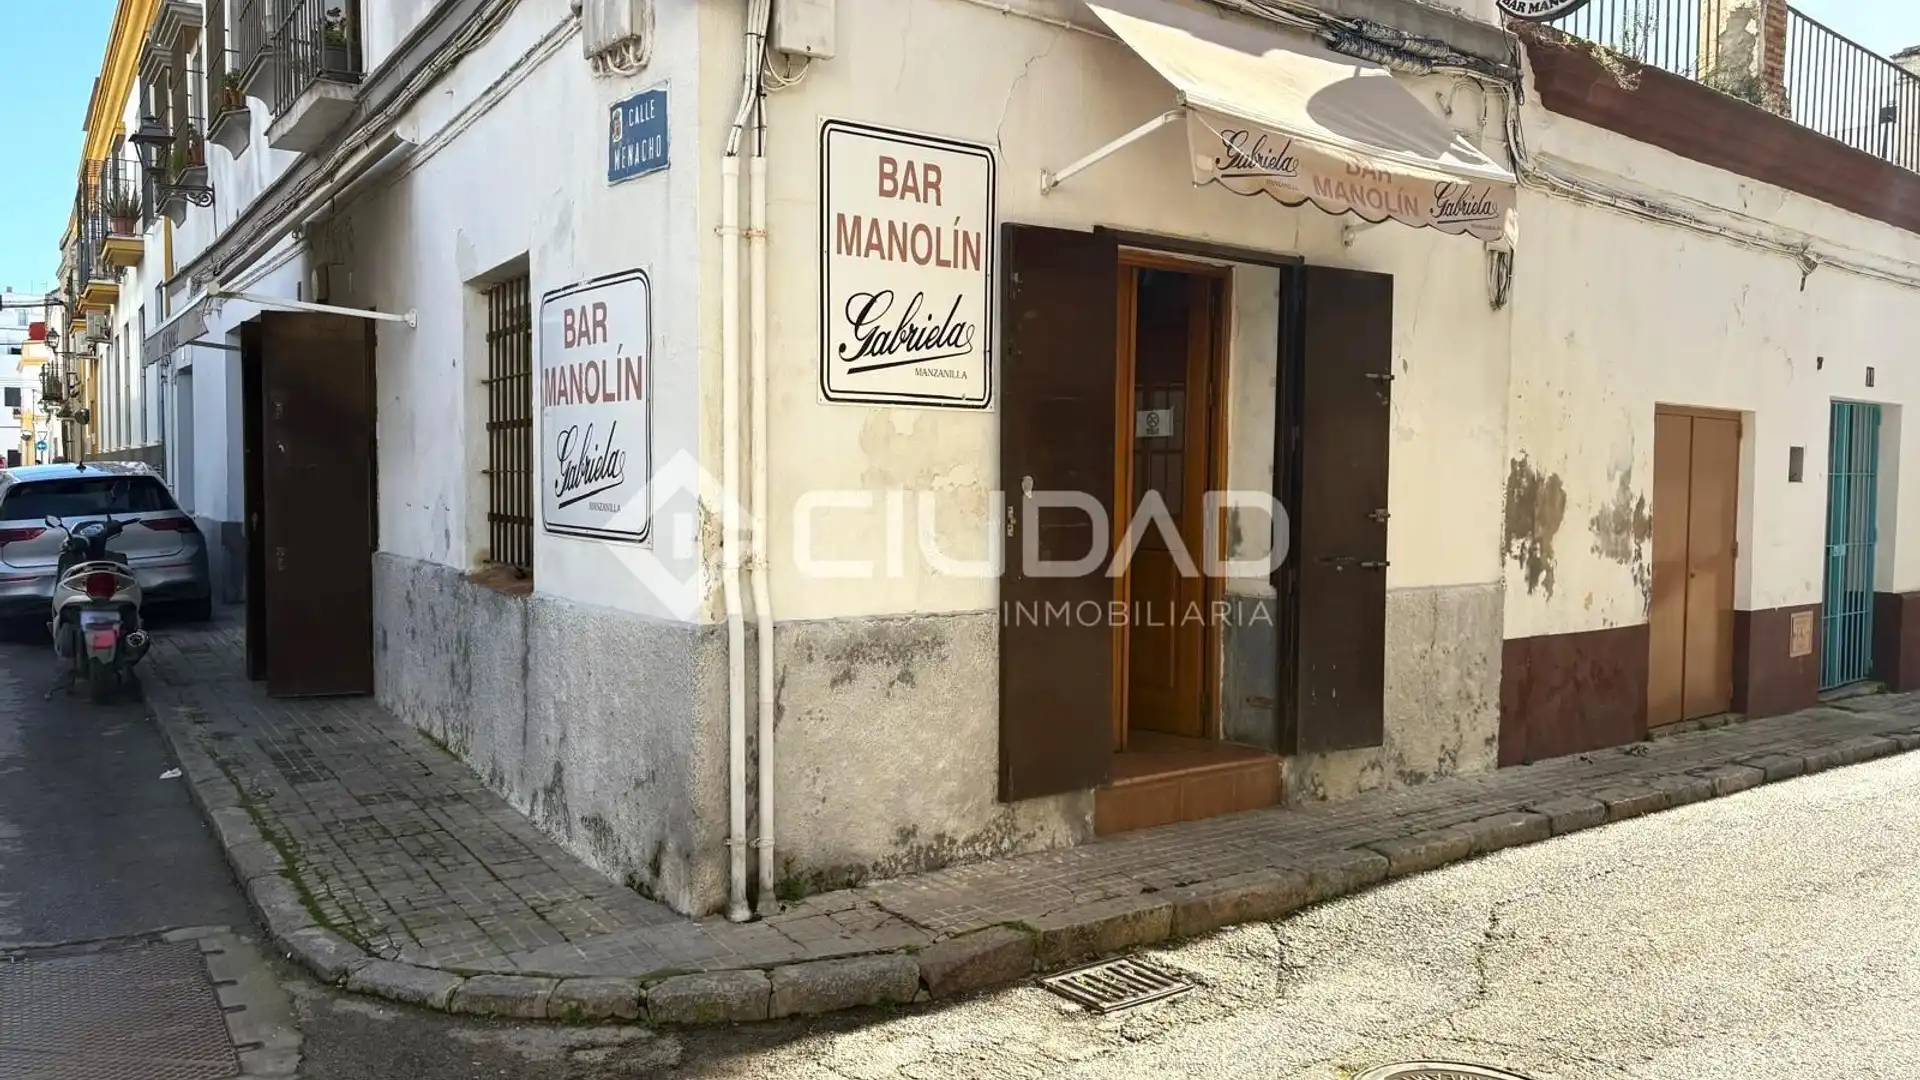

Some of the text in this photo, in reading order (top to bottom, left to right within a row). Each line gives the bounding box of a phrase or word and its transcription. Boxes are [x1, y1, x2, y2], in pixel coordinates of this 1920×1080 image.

[628, 99, 656, 127] CALLE
[614, 134, 662, 171] MENACHO
[1215, 129, 1299, 177] Gabriela
[877, 155, 942, 207] BAR
[1313, 175, 1419, 216] MANOLÍN
[1429, 180, 1500, 223] Gabriela
[836, 212, 981, 271] MANOLÍN
[564, 301, 608, 350] BAR
[838, 289, 973, 372] Gabriela
[544, 343, 643, 407] MANOLÍN
[914, 366, 968, 380] MANZANILLA
[555, 420, 626, 506] Gabriela
